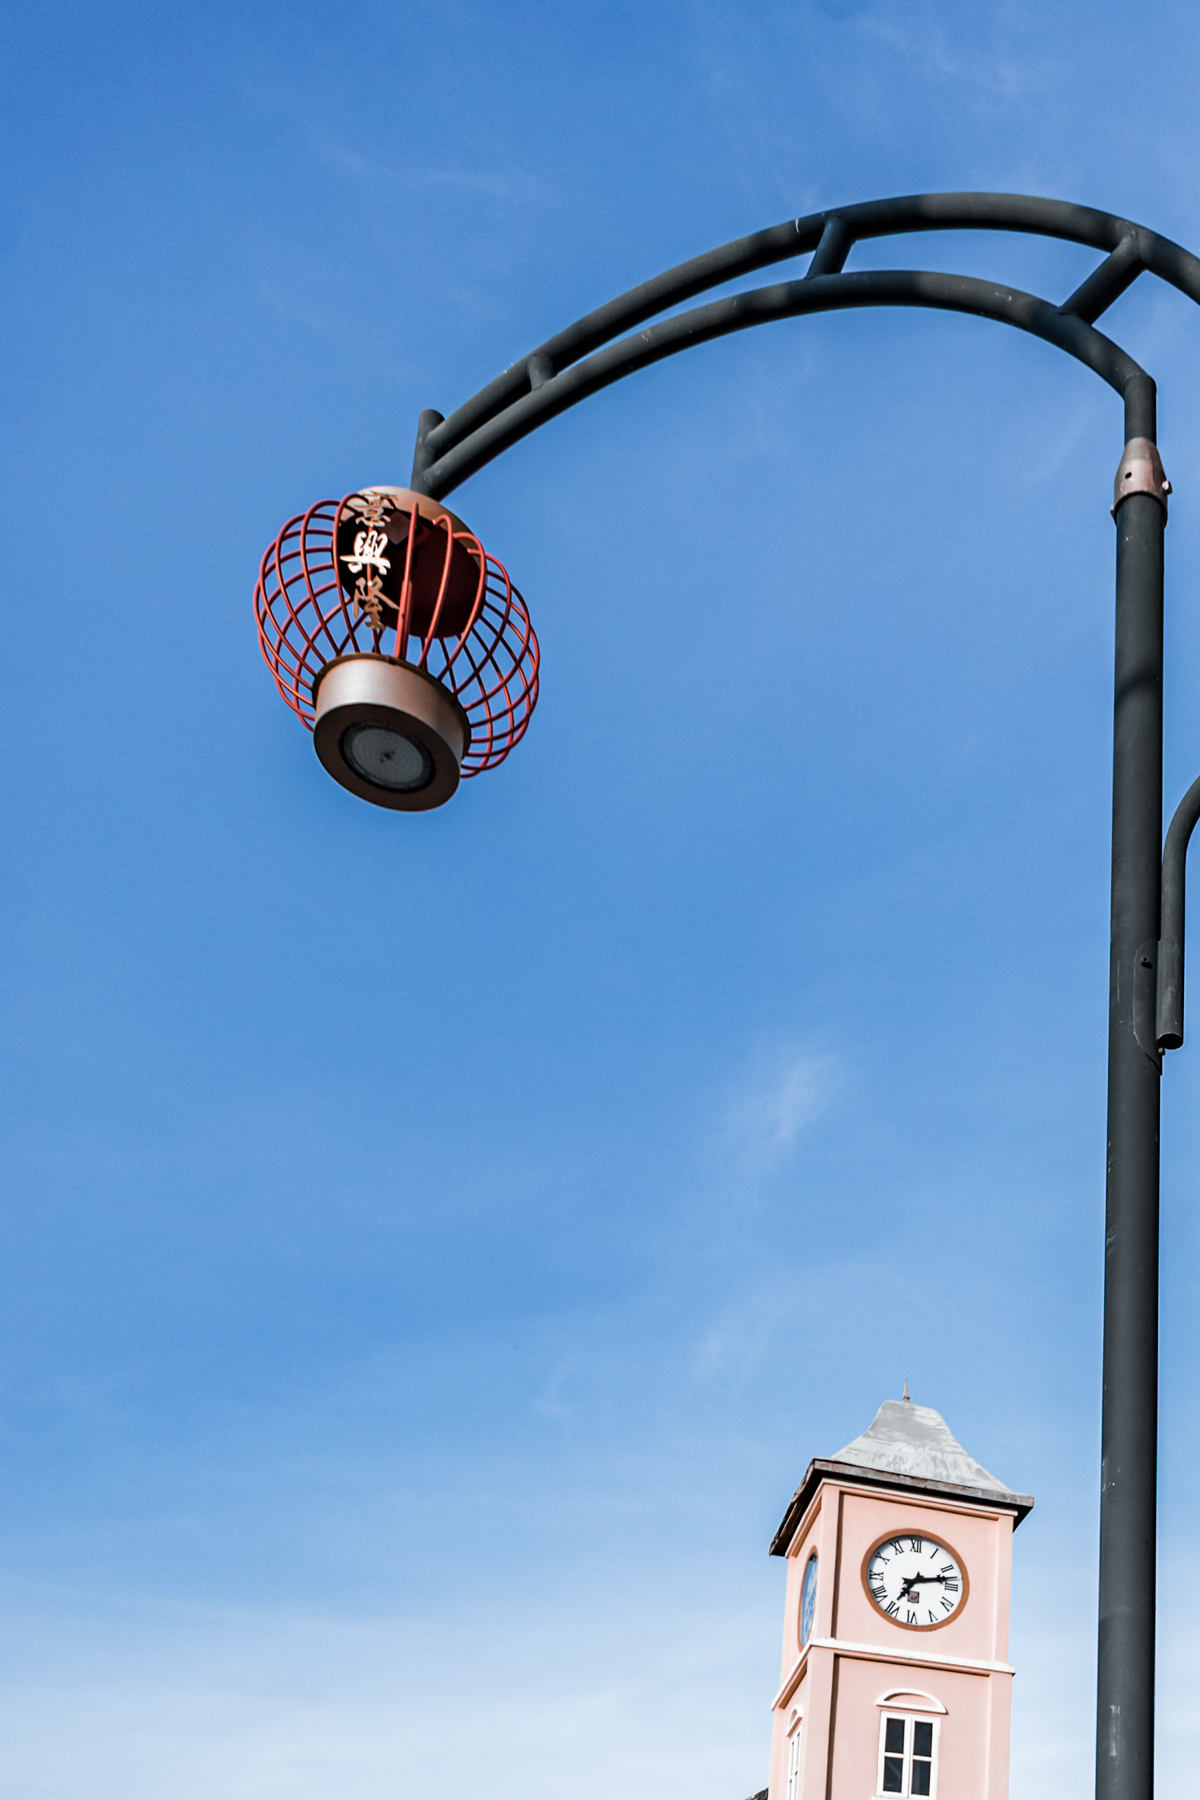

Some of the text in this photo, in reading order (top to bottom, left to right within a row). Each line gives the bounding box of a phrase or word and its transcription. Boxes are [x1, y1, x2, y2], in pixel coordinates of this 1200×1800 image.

[890, 1541, 904, 1555] XI
[910, 1539, 922, 1553] XII
[875, 1552, 890, 1565] X
[940, 1564, 954, 1573] II
[940, 1596, 954, 1612] IV
[906, 1610, 918, 1624] VI
[928, 1609, 938, 1622] V
